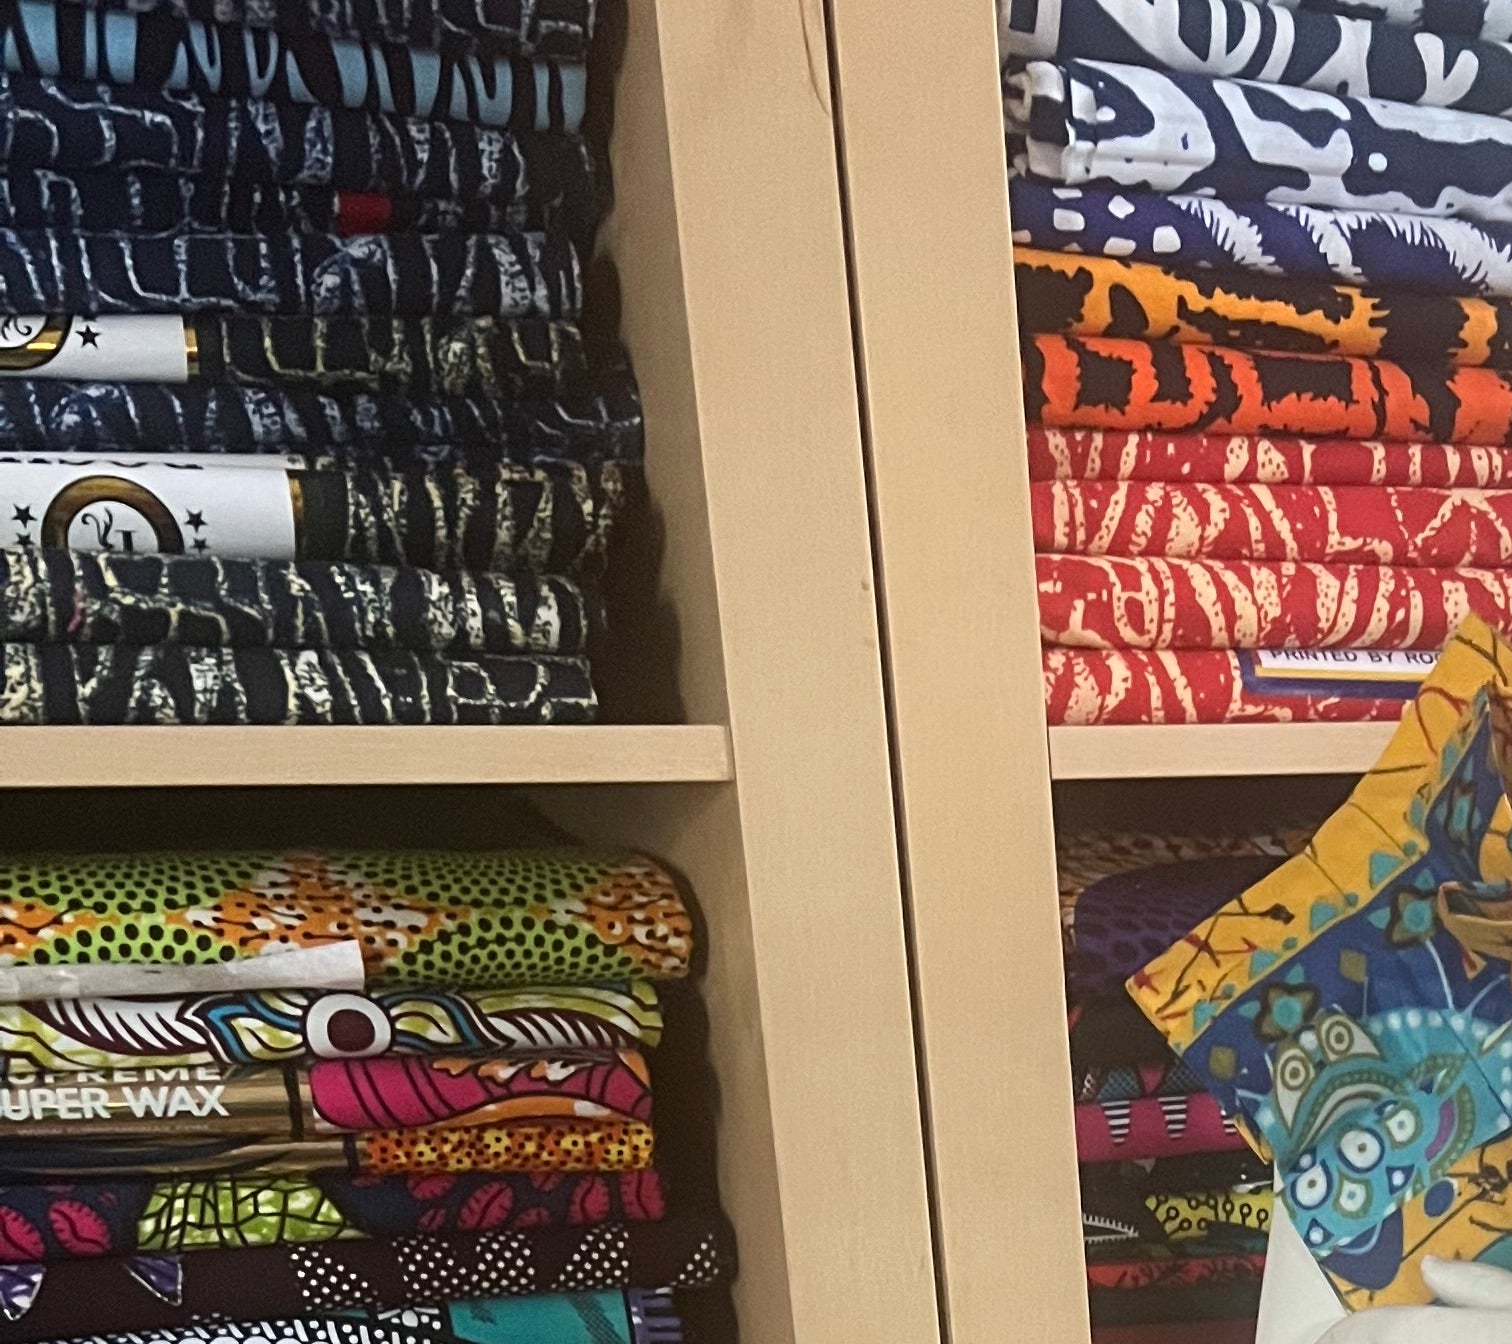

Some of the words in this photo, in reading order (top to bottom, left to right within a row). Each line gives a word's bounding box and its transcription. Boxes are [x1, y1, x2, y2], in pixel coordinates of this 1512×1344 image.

[1369, 651, 1393, 664] BY
[0, 1086, 112, 1121] UPER
[121, 1085, 231, 1118] WAX
